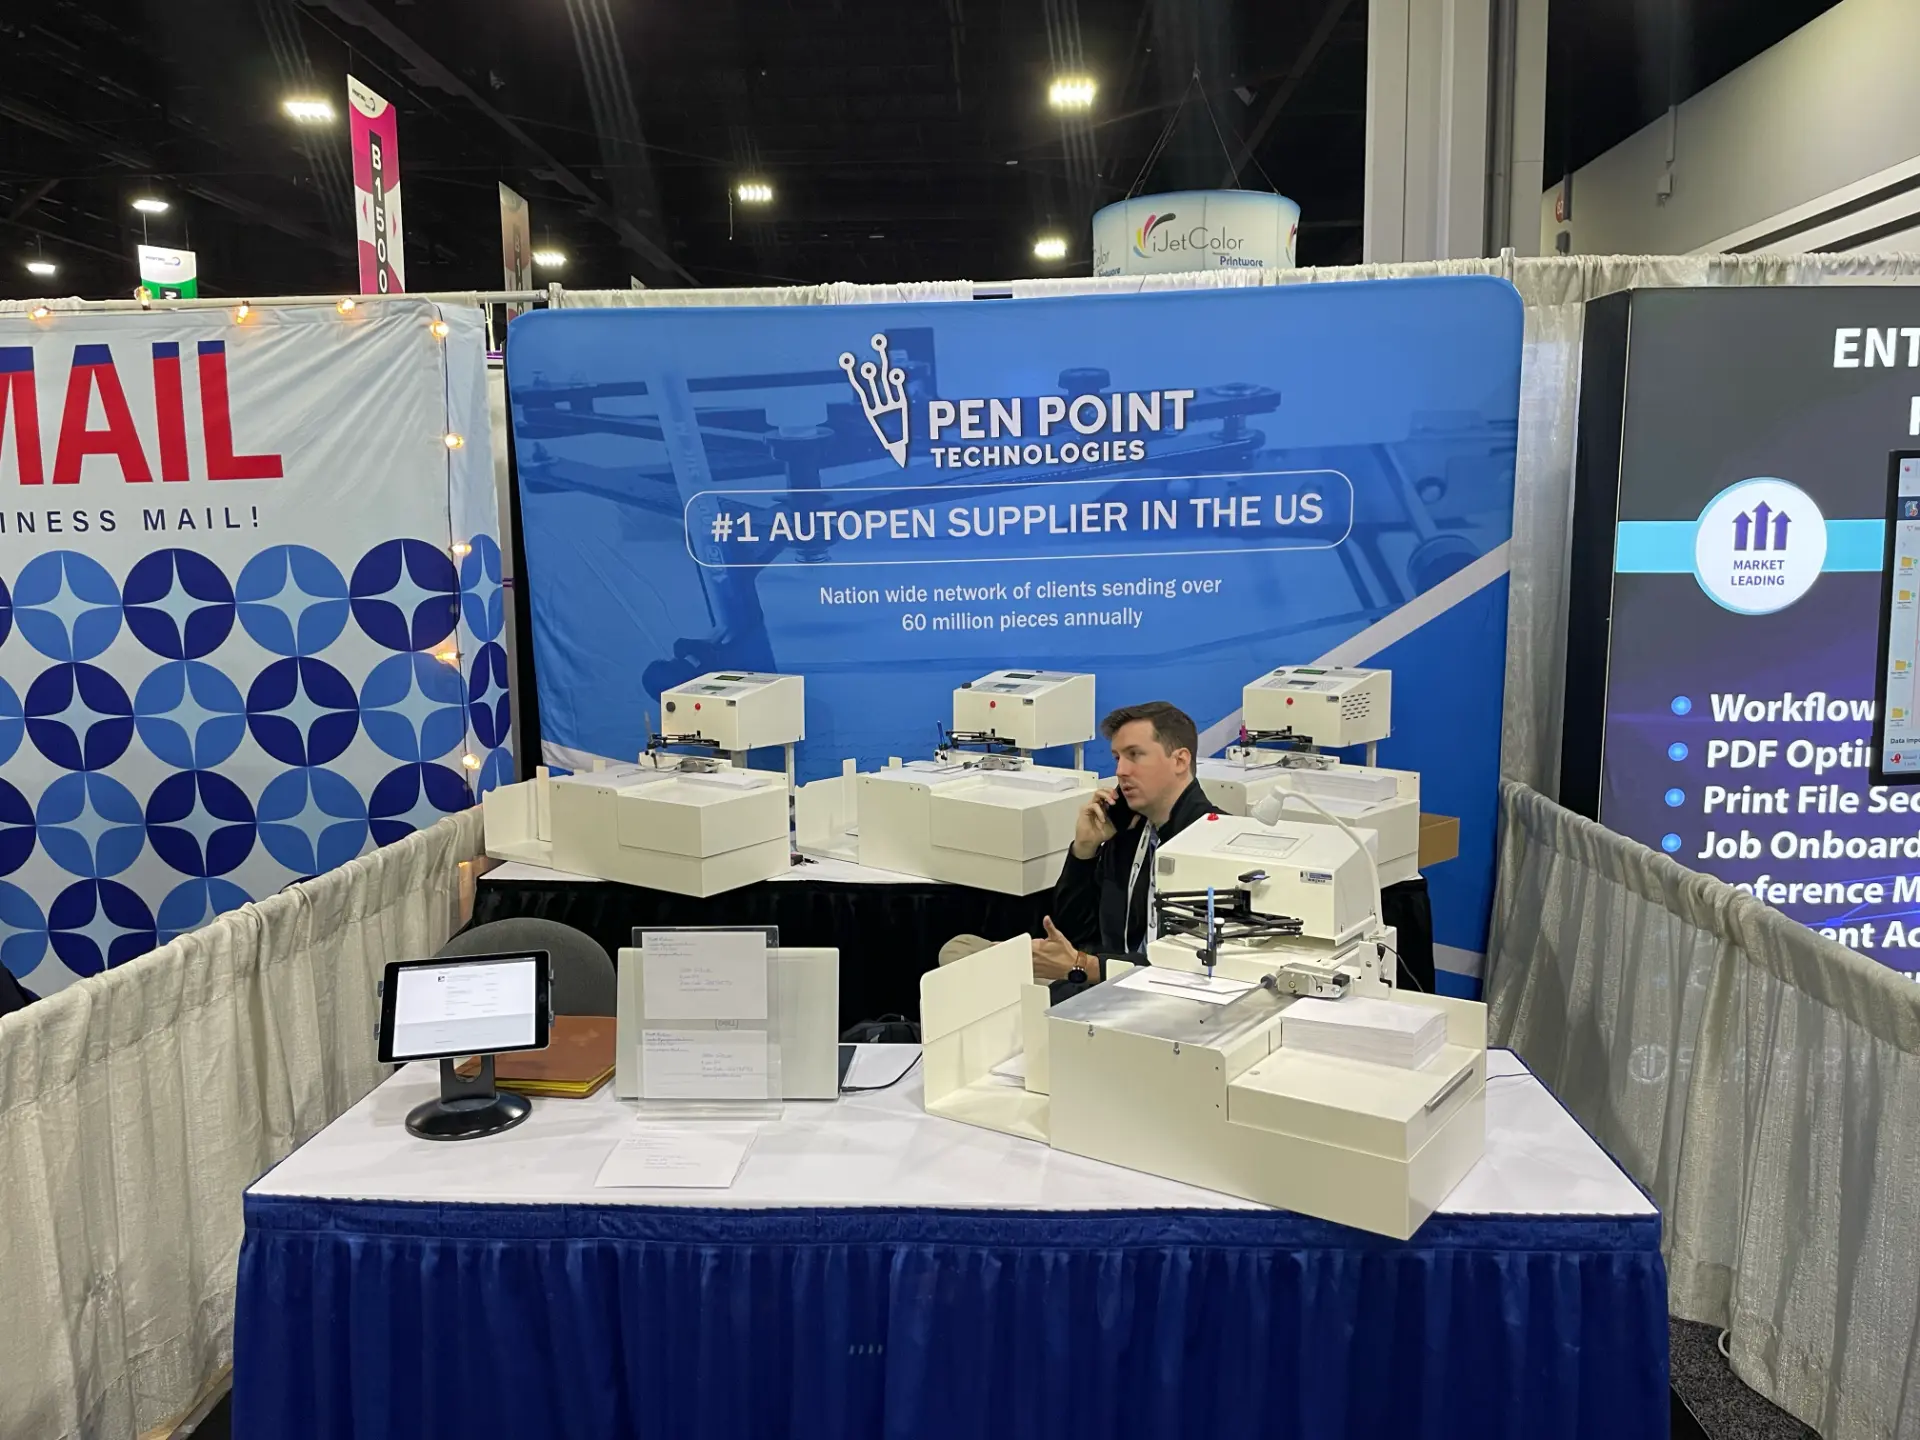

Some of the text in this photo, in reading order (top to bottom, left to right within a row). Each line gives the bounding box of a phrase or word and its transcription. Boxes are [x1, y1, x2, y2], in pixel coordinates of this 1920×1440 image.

[1152, 226, 1244, 252] iJetColor
[1220, 255, 1264, 267] Printware
[1833, 327, 1920, 368] ENT
[928, 389, 1195, 440] PEN POINT
[930, 439, 1145, 468] TECHNOLOGIES
[0, 506, 258, 534] INESS MAIL!
[711, 492, 1324, 543] #1 AUTOPEN SUPPLIER IN THE US
[1733, 559, 1785, 571] MARKET
[820, 577, 1222, 605] Nation wide network of clients sending over
[1730, 575, 1785, 586] LEADING
[902, 607, 1143, 632] 60 million pieces annually
[1710, 691, 1875, 722] Workflow
[1707, 738, 1871, 775] PDF Opti
[1704, 785, 1790, 814] Print
[1798, 784, 1860, 814] File
[1697, 830, 1920, 859] Job Onboard
